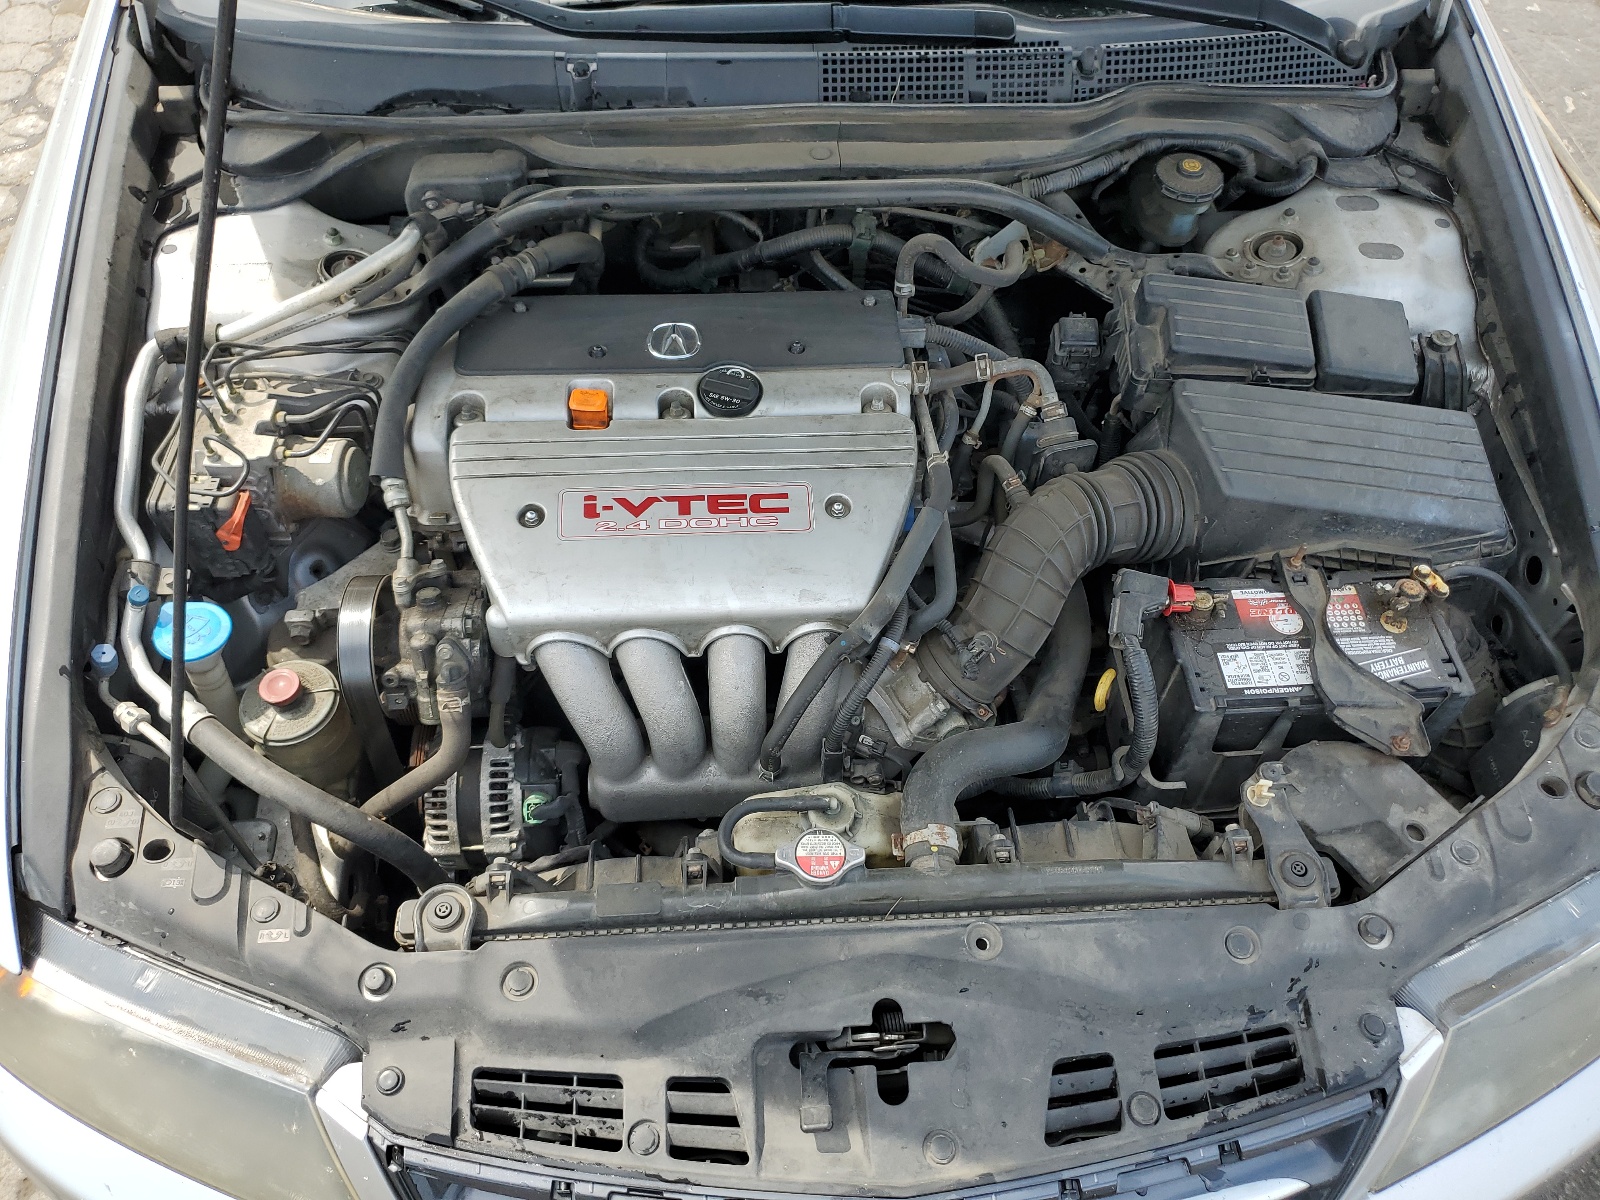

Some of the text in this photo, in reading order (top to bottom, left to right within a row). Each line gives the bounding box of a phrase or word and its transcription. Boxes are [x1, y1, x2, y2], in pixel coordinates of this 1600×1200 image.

[583, 493, 790, 519] i-VTEC
[594, 515, 779, 532] 2.4 DOHC
[1369, 656, 1405, 673] BATTERY
[1243, 686, 1302, 695] ANGER/POISON
